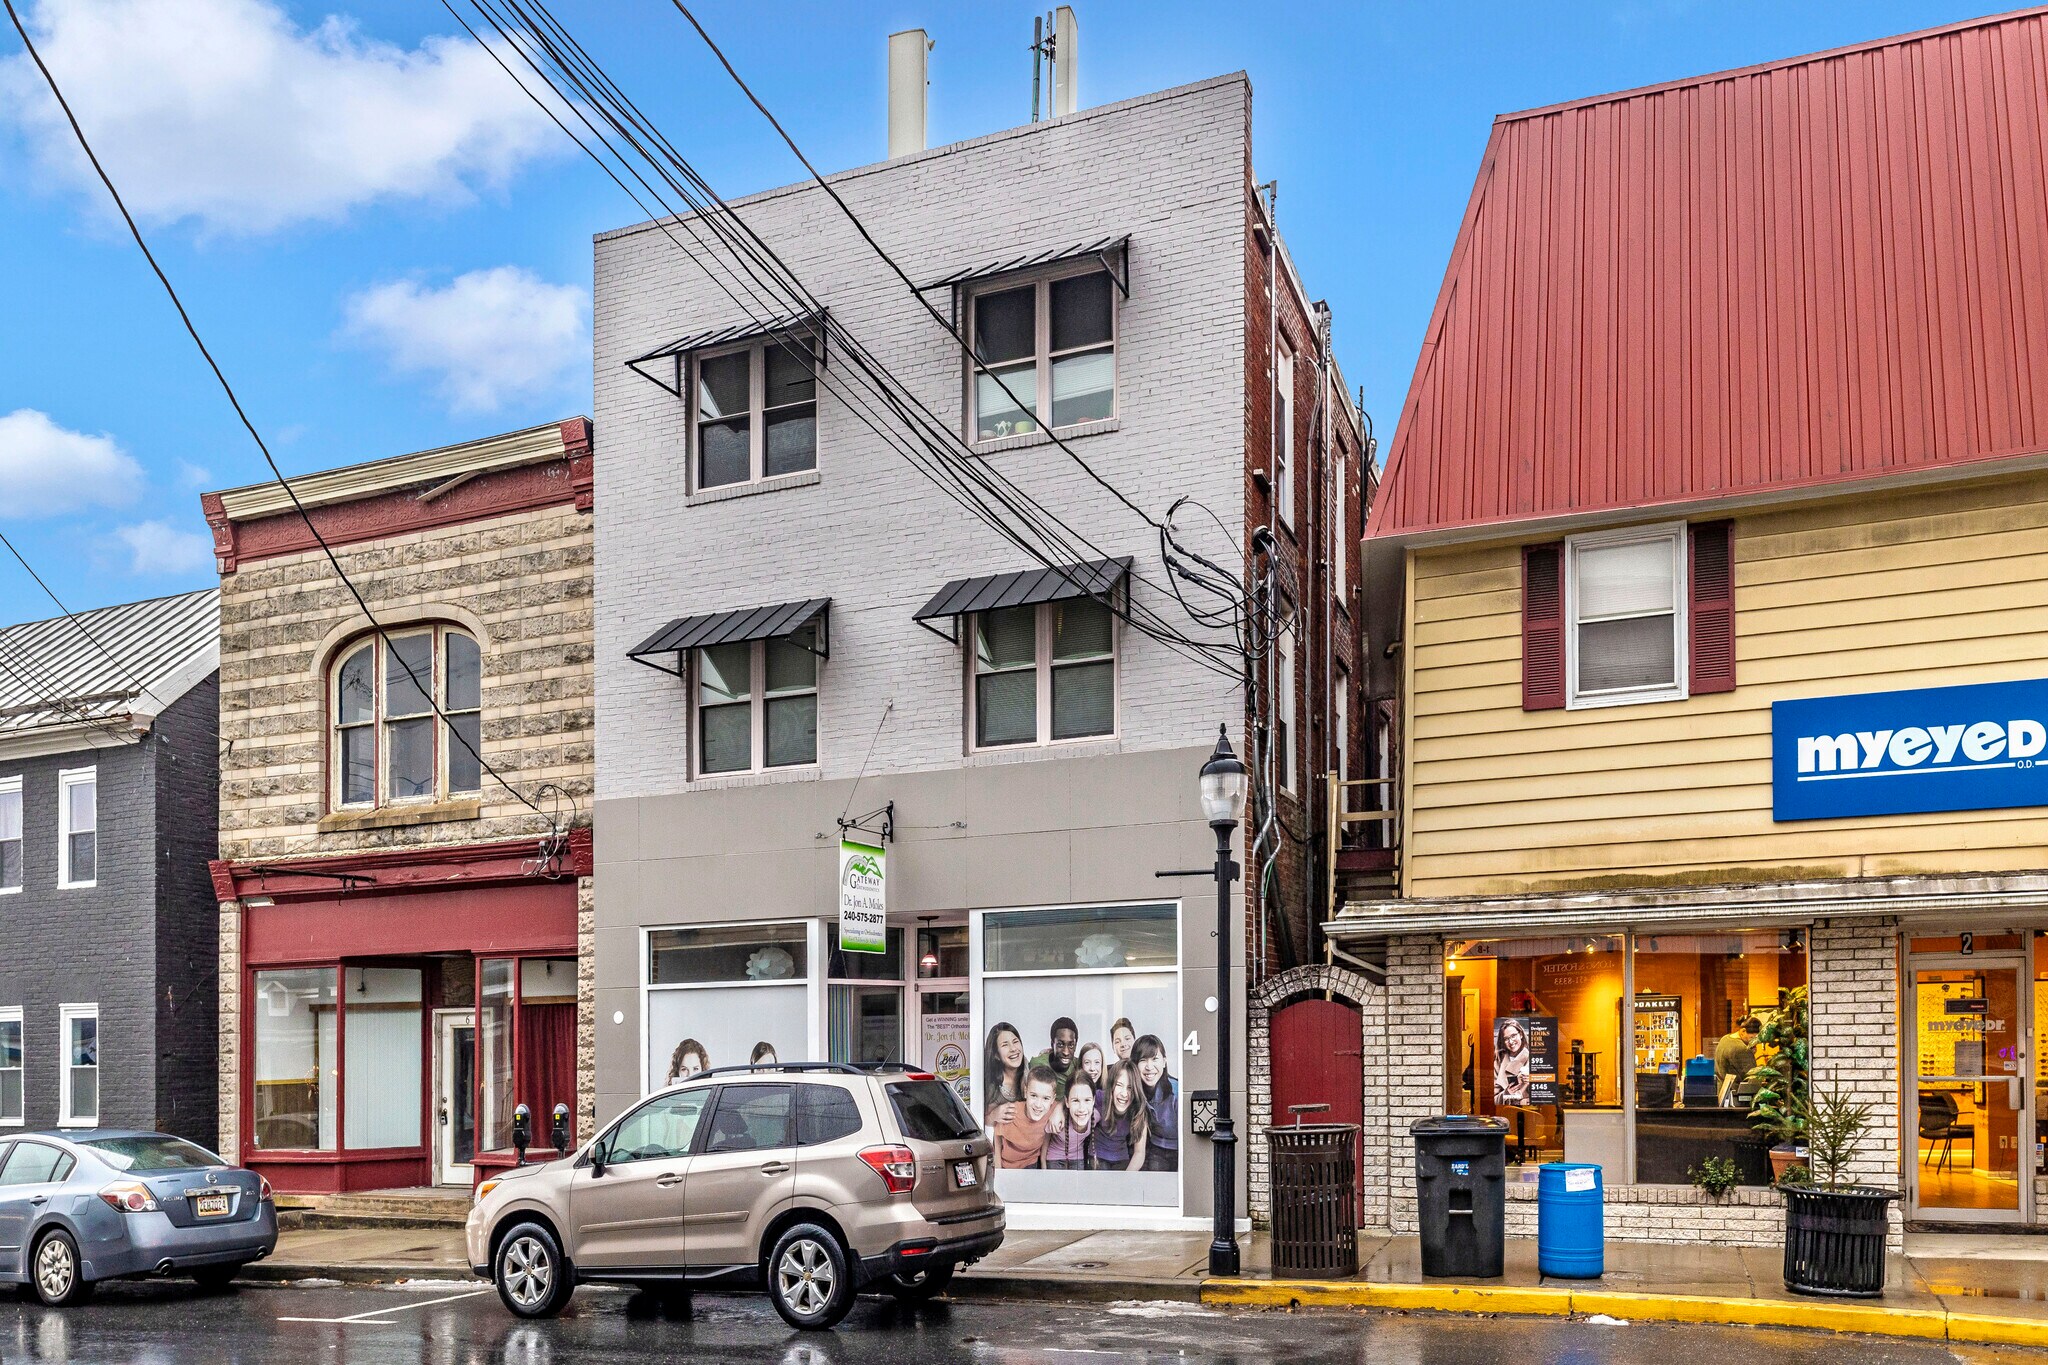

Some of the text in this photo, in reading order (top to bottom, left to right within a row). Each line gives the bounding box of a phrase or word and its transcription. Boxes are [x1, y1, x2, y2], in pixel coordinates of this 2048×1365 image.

[2017, 760, 2035, 769] O.D.
[850, 873, 880, 889] GATEWAY
[844, 894, 884, 910] Dr. Jon A. Moles
[844, 911, 884, 924] 240-575-2877
[1963, 934, 1972, 953] 2
[1183, 1031, 1200, 1055] 4
